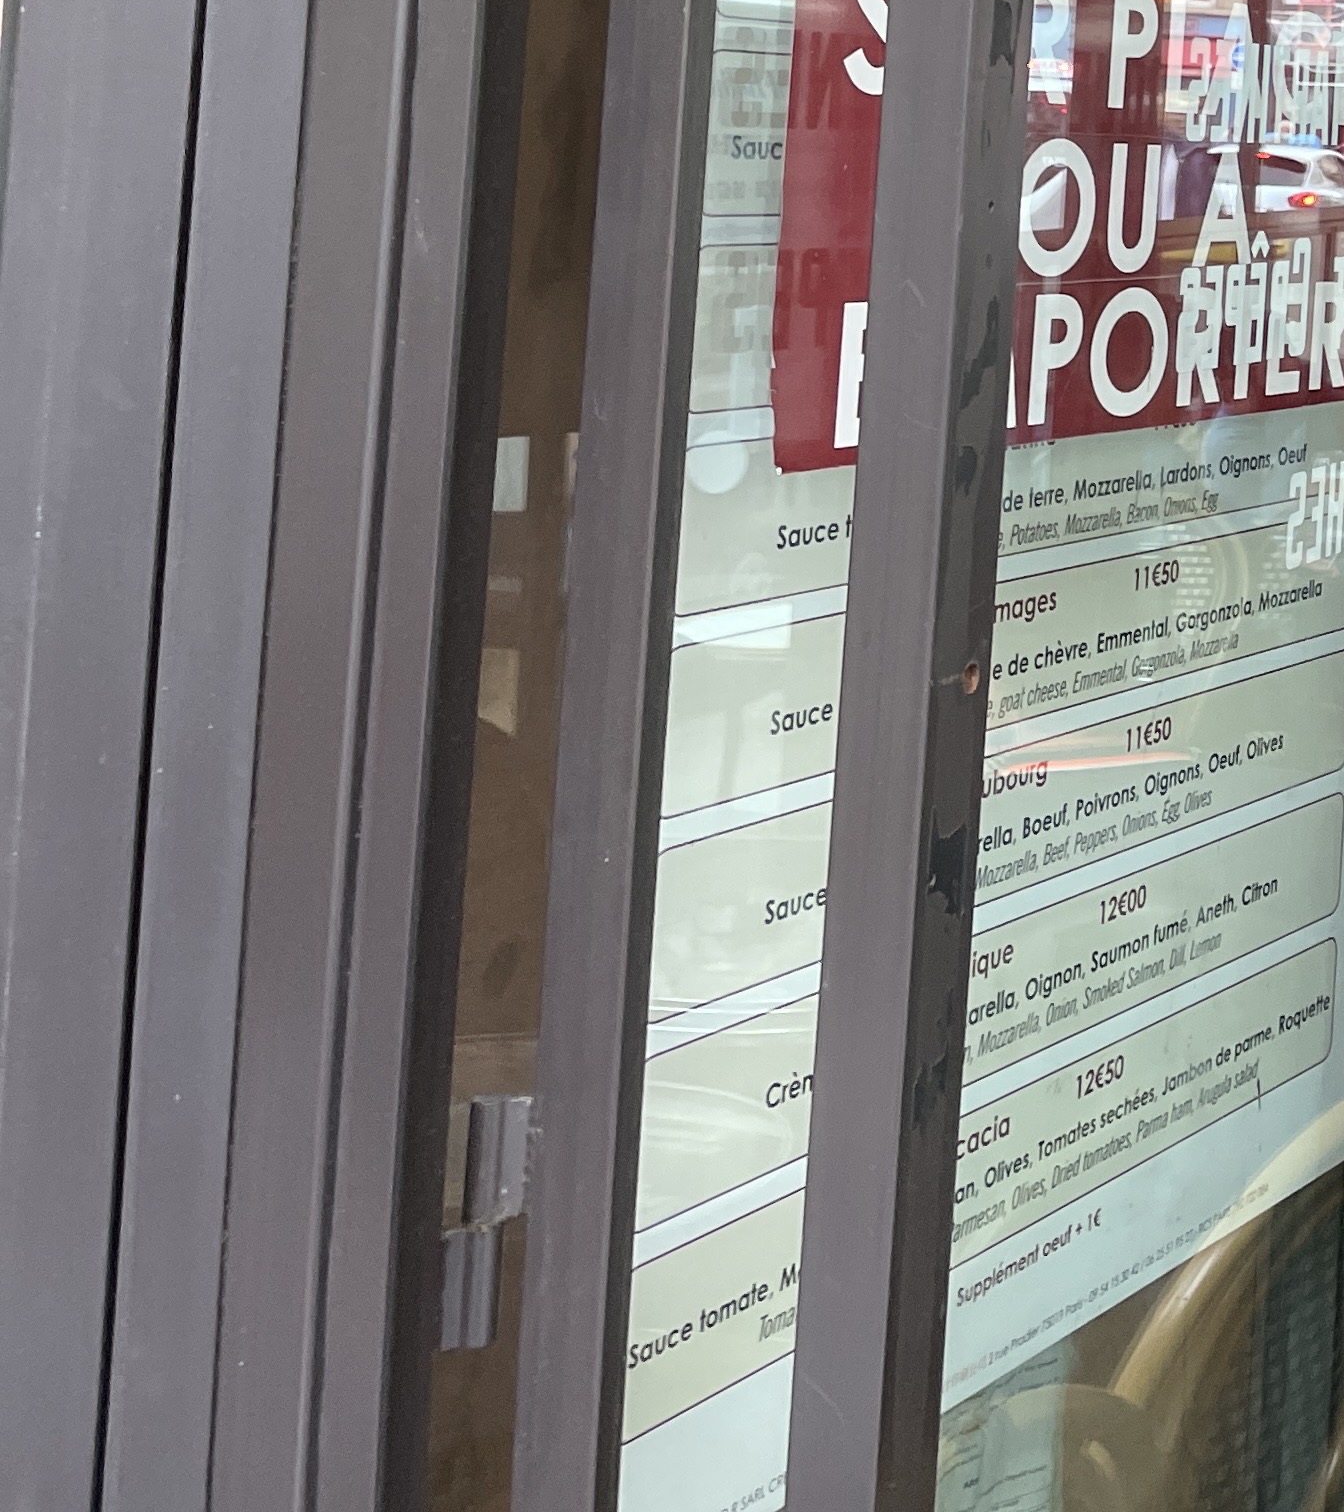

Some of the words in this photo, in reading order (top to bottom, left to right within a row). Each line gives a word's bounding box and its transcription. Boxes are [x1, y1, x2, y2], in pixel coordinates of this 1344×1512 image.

[1018, 138, 1162, 278] OU
[1003, 491, 1023, 513] de
[1073, 471, 1155, 502] Mozzarella,
[1160, 461, 1215, 487] Lardons,
[1220, 451, 1274, 478] Oignons,
[776, 520, 839, 550] Sauce
[1134, 559, 1180, 591] 11€50
[1008, 655, 1029, 677] de
[1034, 640, 1091, 671] chèvre,
[1097, 616, 1171, 655] Emmental,
[1176, 599, 1255, 634] Gorgonzola,
[1258, 580, 1323, 612] Mozzarella
[770, 702, 834, 737] Sauce
[1126, 716, 1172, 753] 11€50
[1023, 806, 1070, 838] Boeuf,
[1075, 784, 1139, 821] Poivrons,
[1144, 763, 1204, 796] Oignons,
[1208, 745, 1243, 774] Oeuf,
[1247, 734, 1284, 760] Olives
[764, 886, 828, 925] Sauce
[1100, 884, 1148, 924] 12€00
[1025, 963, 1086, 1000] Oignon,
[1091, 933, 1149, 973] Saumon
[1153, 909, 1191, 944] fumé,
[1195, 896, 1238, 928] Aneth,
[1241, 878, 1279, 907] Citron
[984, 1151, 1033, 1190] Olives,
[1038, 1121, 1097, 1164] Tomates
[1161, 1057, 1213, 1099] Jambon
[1215, 1044, 1231, 1068] de
[1234, 1028, 1275, 1062] parme,
[1278, 994, 1331, 1035] Roquette
[1076, 1054, 1125, 1100] 12€50
[957, 1244, 1040, 1307] Supplément
[628, 1322, 694, 1370] Sauce
[699, 1282, 775, 1333] tomate,
